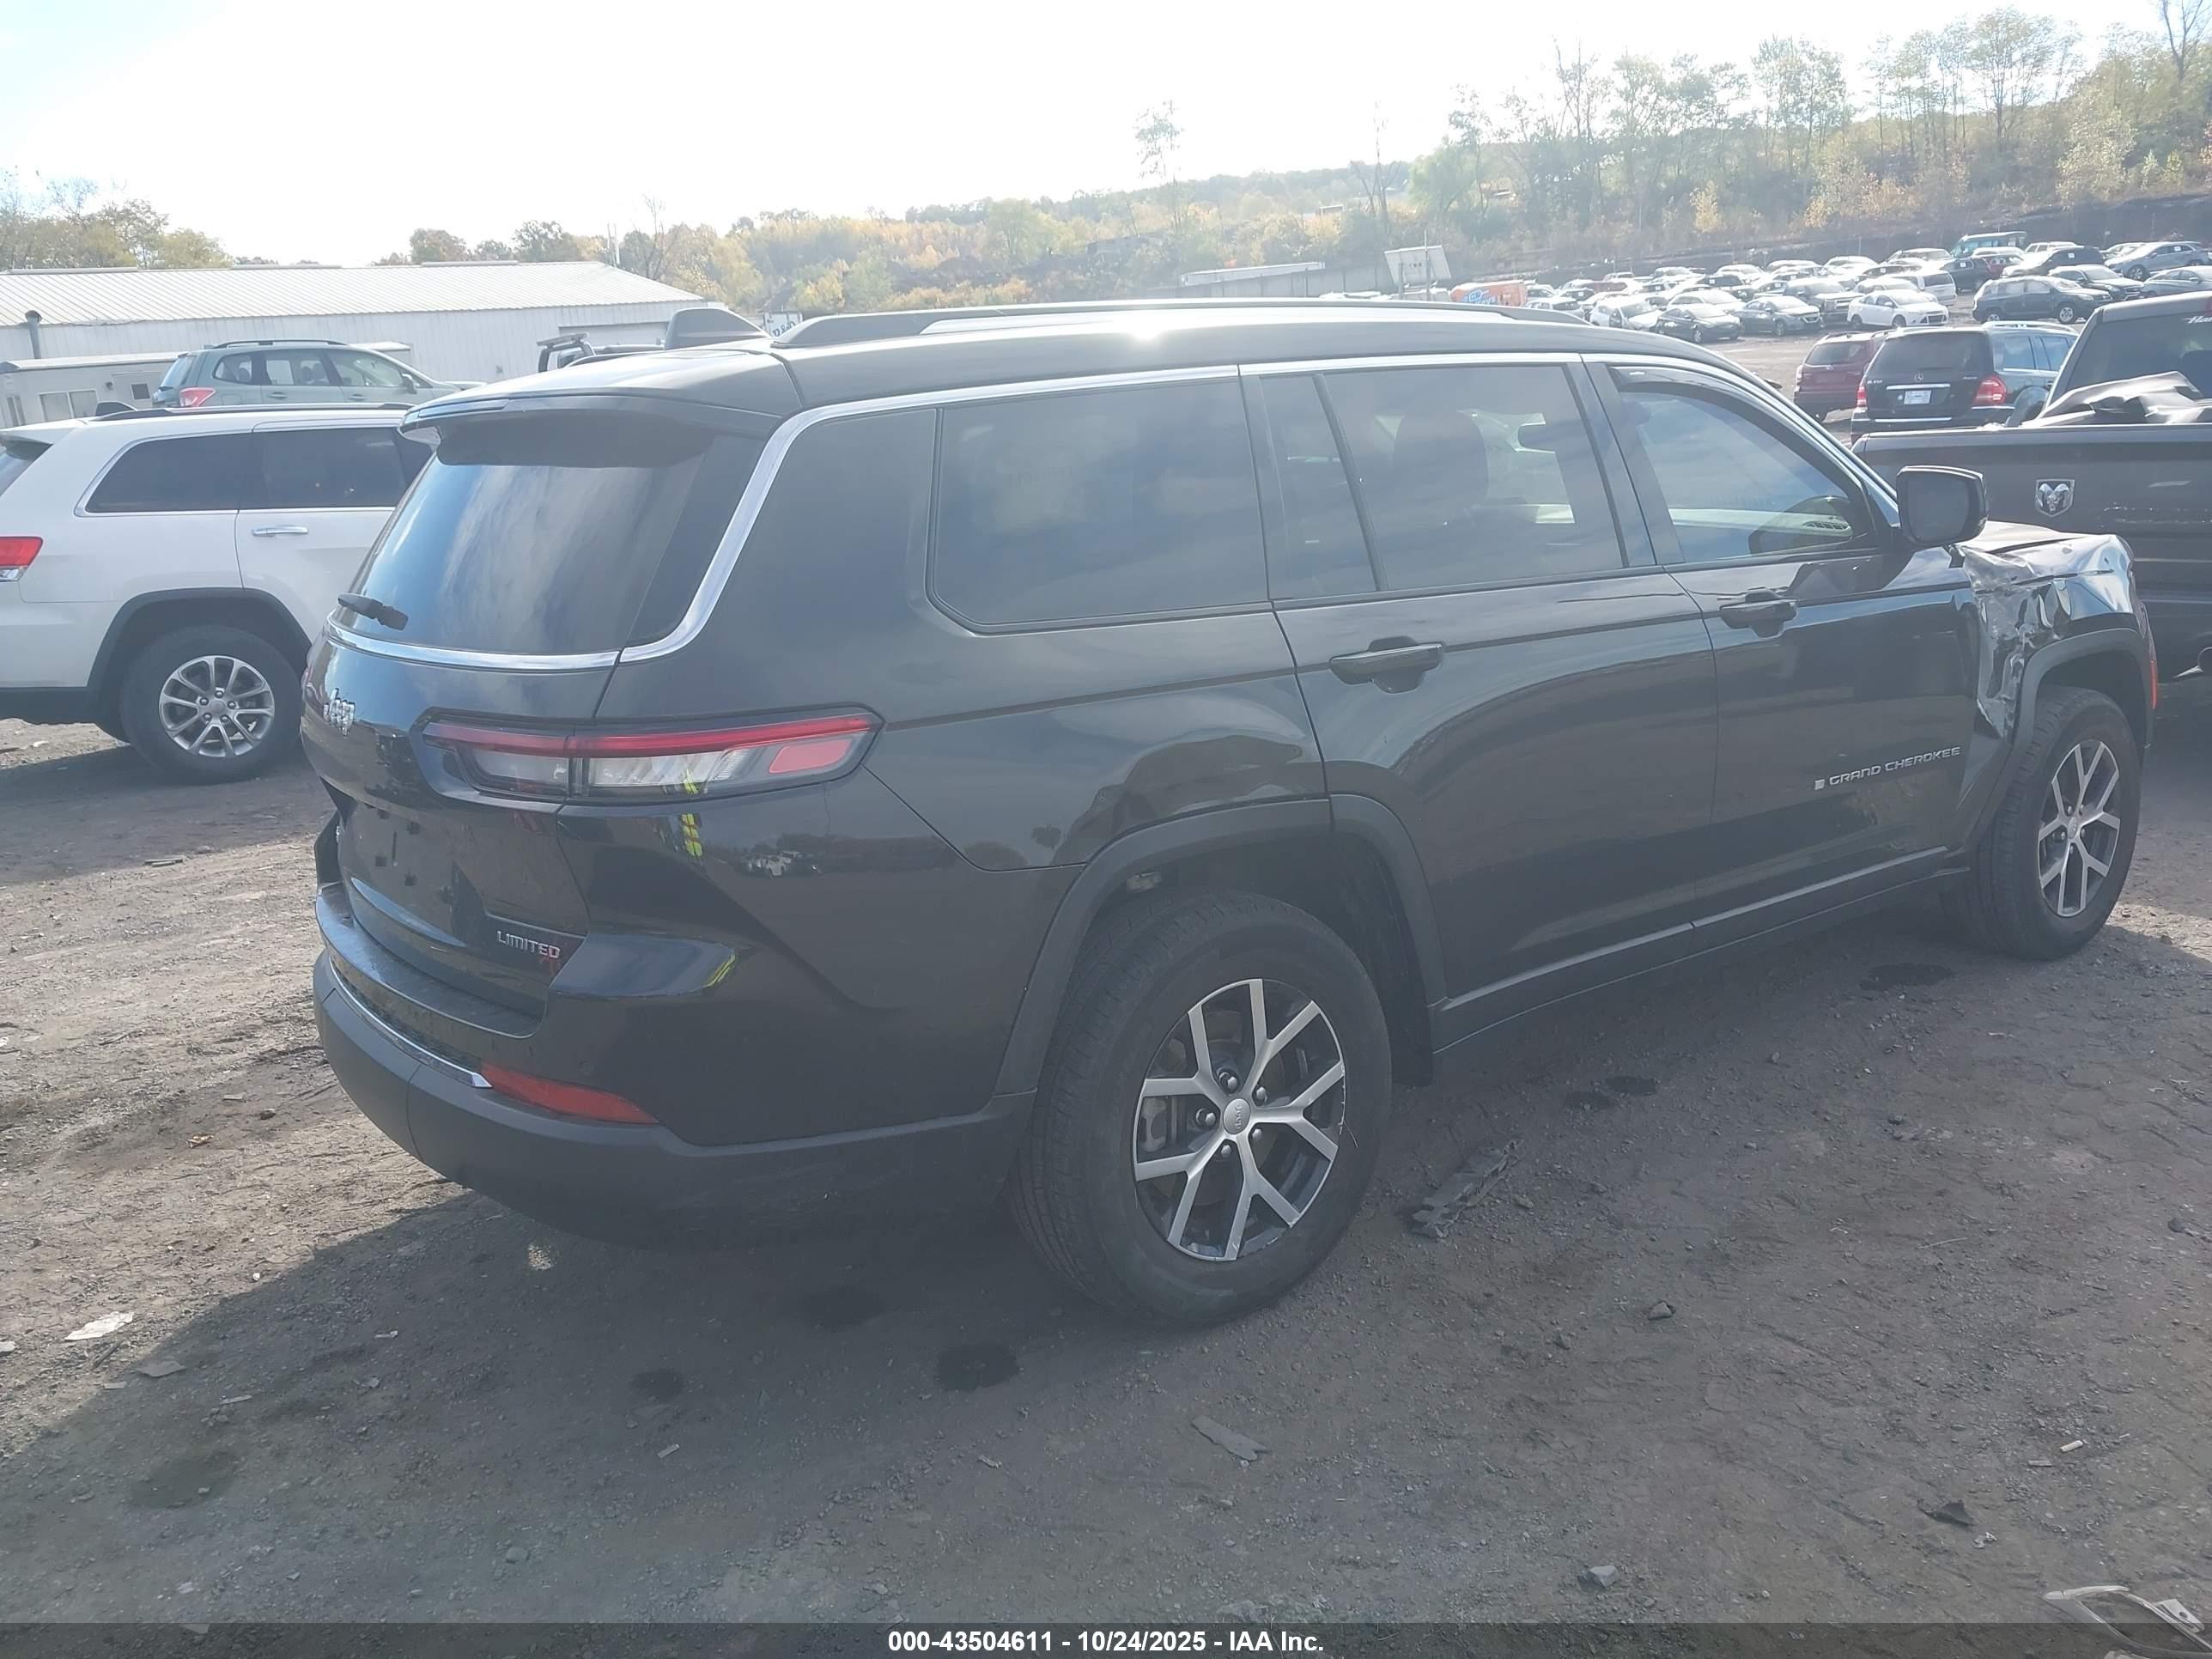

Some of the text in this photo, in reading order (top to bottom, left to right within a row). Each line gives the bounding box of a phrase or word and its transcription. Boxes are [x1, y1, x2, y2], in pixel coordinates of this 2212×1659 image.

[1829, 746, 1961, 785] GRAND CHEROKEE
[497, 931, 561, 958] LIMITED
